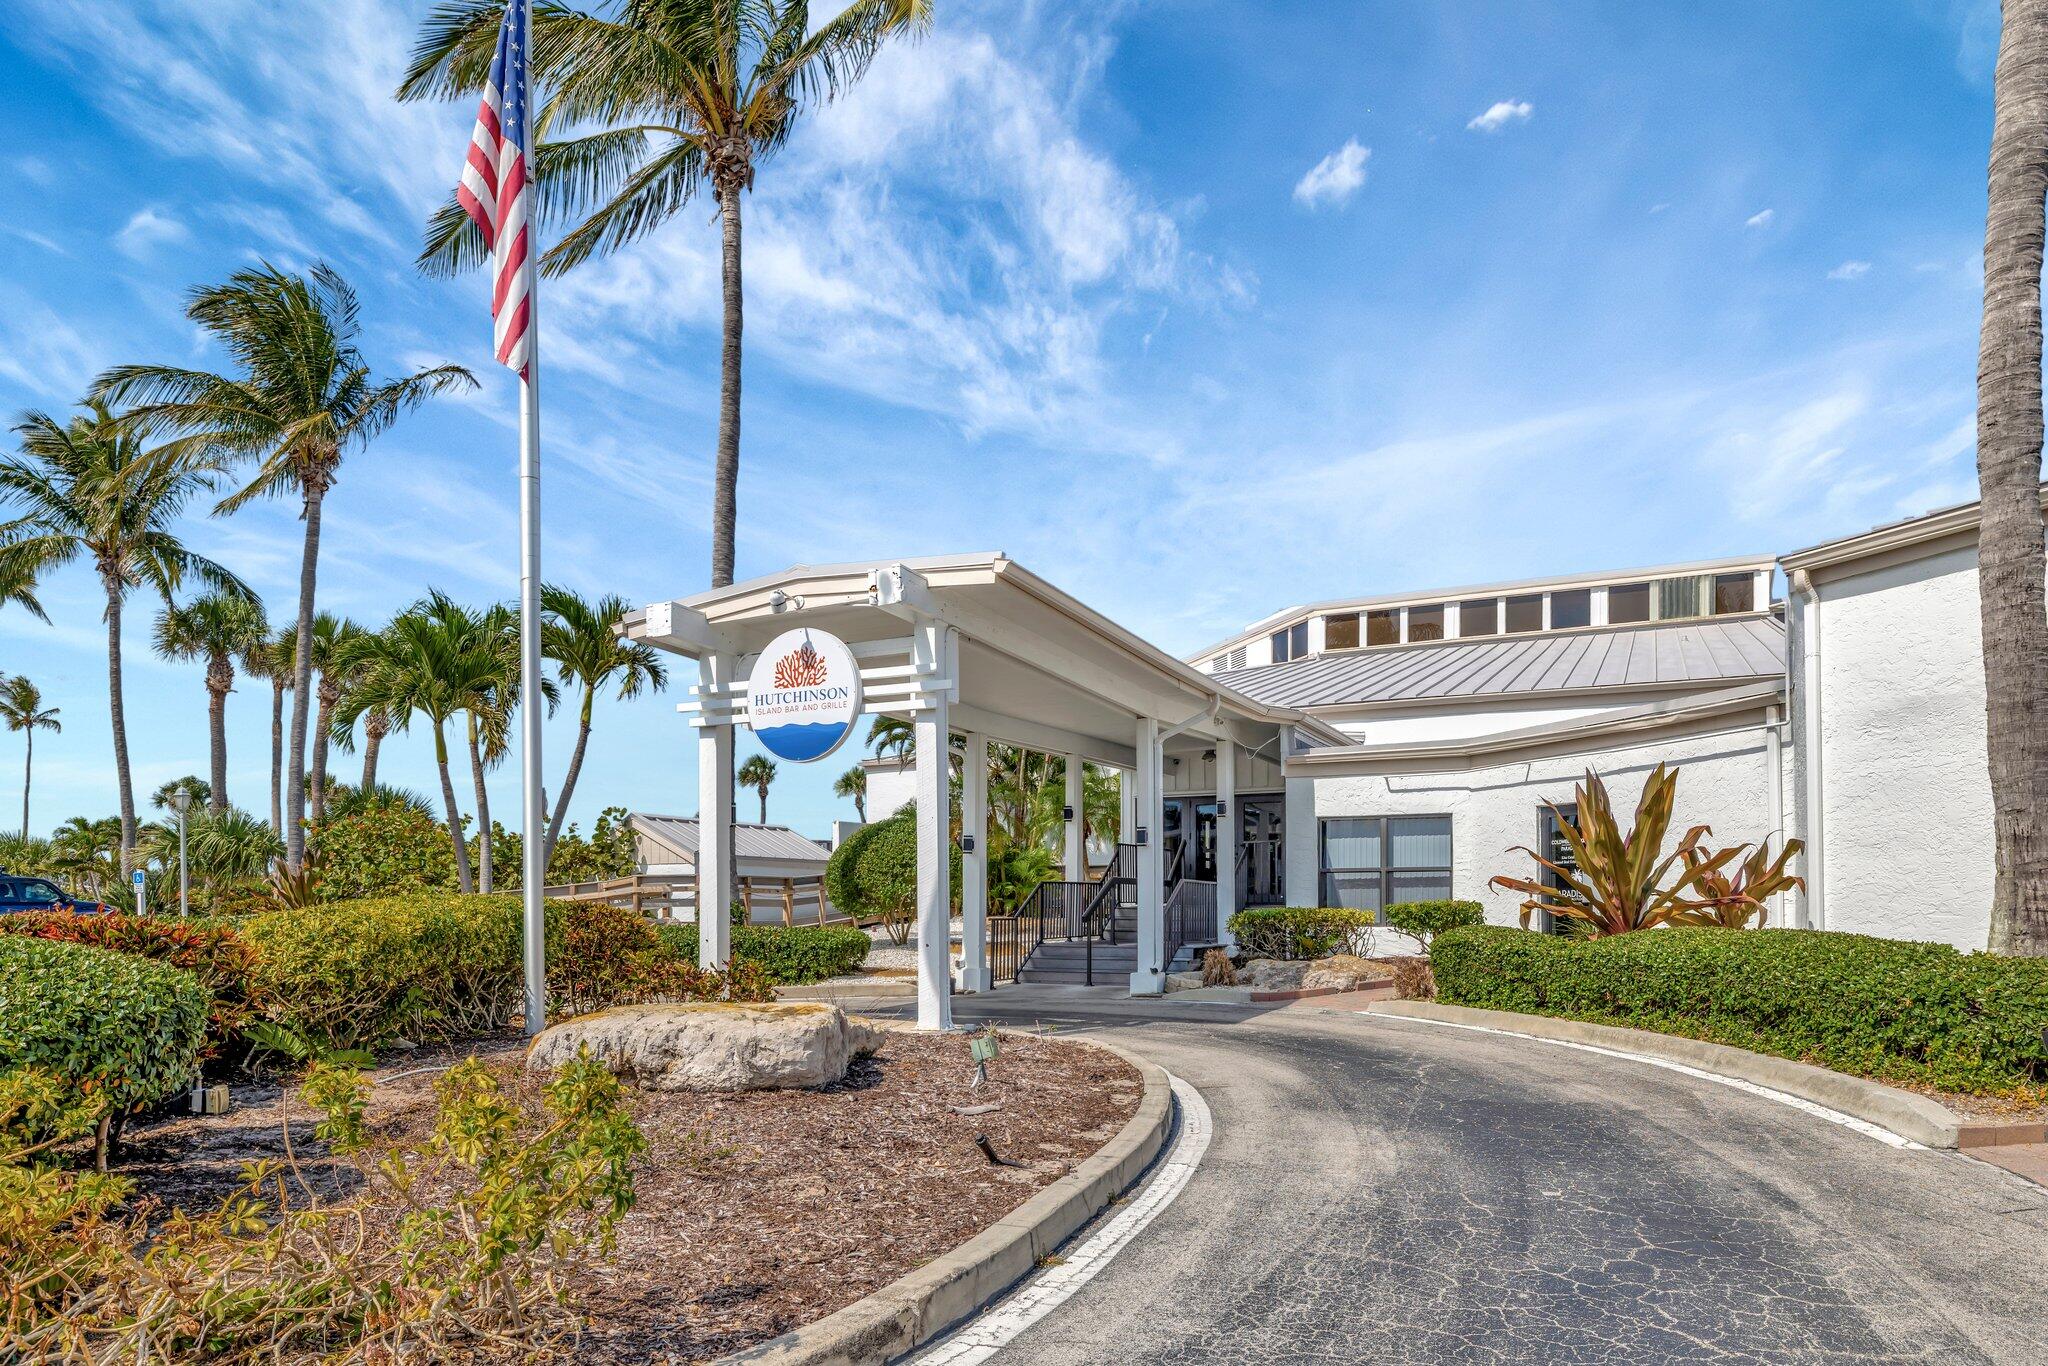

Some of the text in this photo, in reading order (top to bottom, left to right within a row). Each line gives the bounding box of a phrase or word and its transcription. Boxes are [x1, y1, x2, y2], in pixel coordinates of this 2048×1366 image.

[755, 687, 848, 706] HUTCHINSON
[755, 706, 782, 716] ISLAND
[785, 705, 799, 713] BAR
[821, 701, 848, 710] GRILLE
